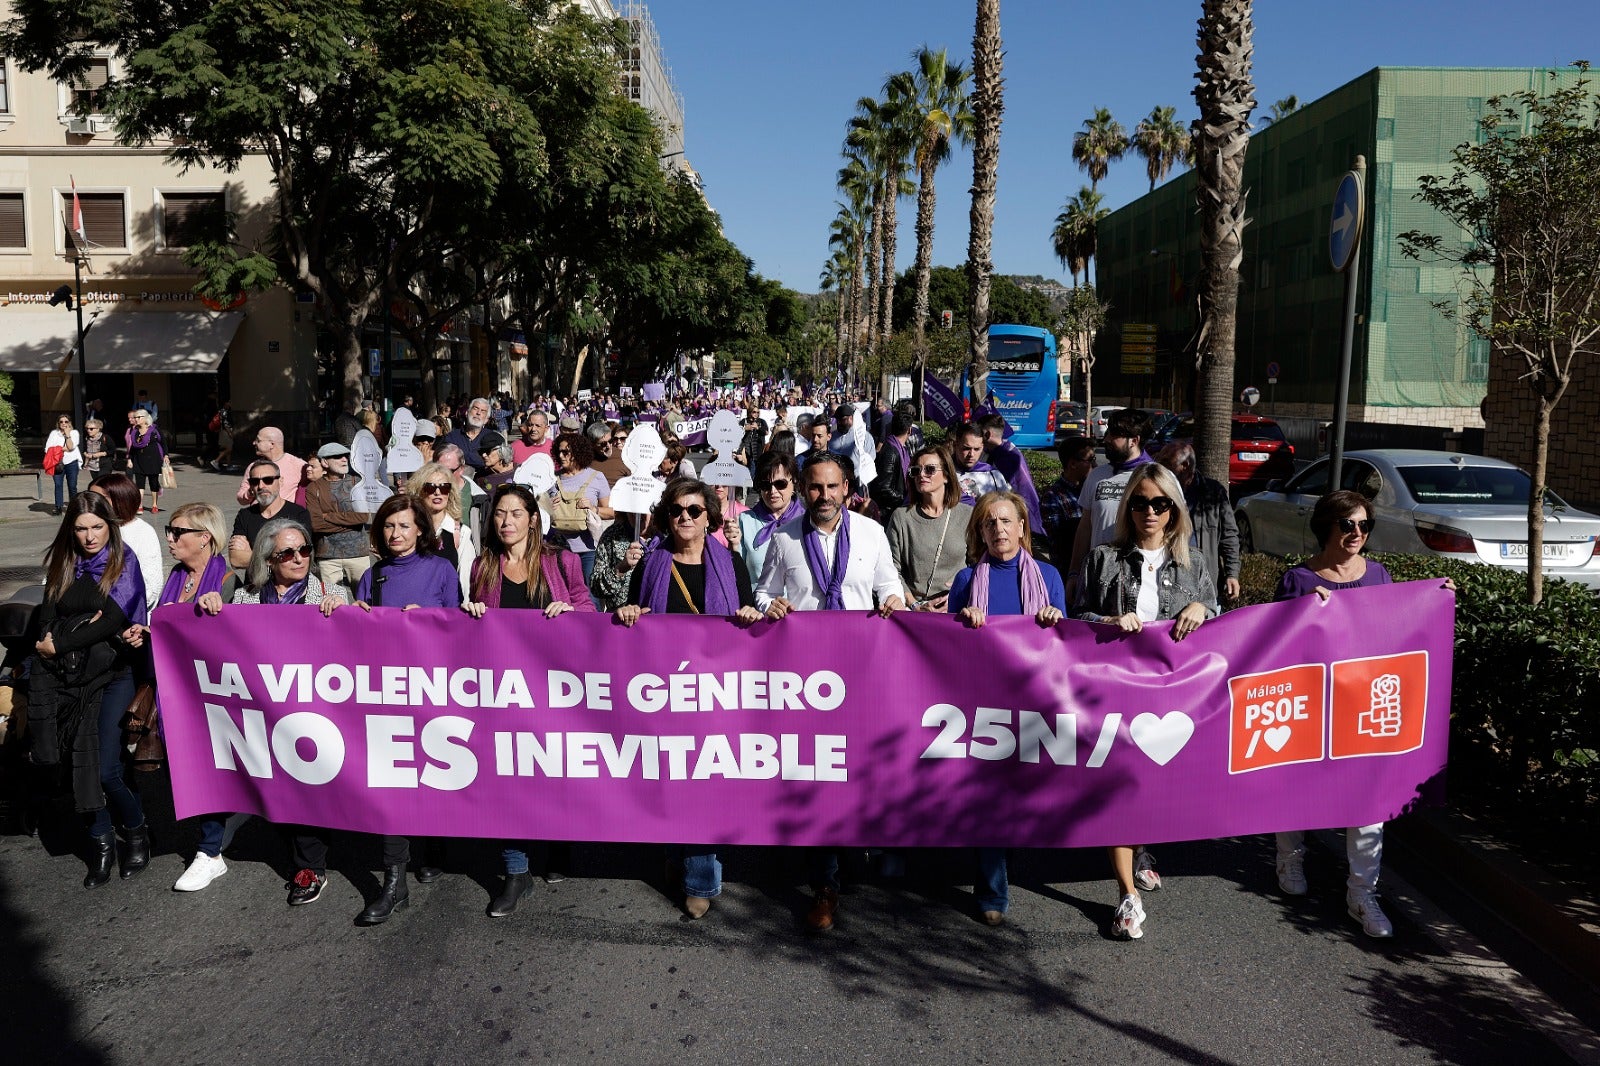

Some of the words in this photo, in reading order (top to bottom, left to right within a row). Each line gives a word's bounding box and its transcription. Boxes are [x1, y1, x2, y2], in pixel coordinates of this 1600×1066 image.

[87, 291, 126, 301] Oficina
[687, 418, 711, 433] BAR
[1543, 545, 1563, 556] CWV
[194, 660, 253, 700] LA
[257, 662, 535, 709] VIOLENCIA
[547, 669, 613, 711] DE
[626, 660, 847, 714] GÉNERO
[1246, 682, 1293, 700] Málaga
[1245, 695, 1309, 730] PSOE
[203, 702, 346, 786] NO
[365, 714, 479, 791] ES
[494, 731, 848, 783] INEVITABLE
[920, 703, 1077, 767] 25N
